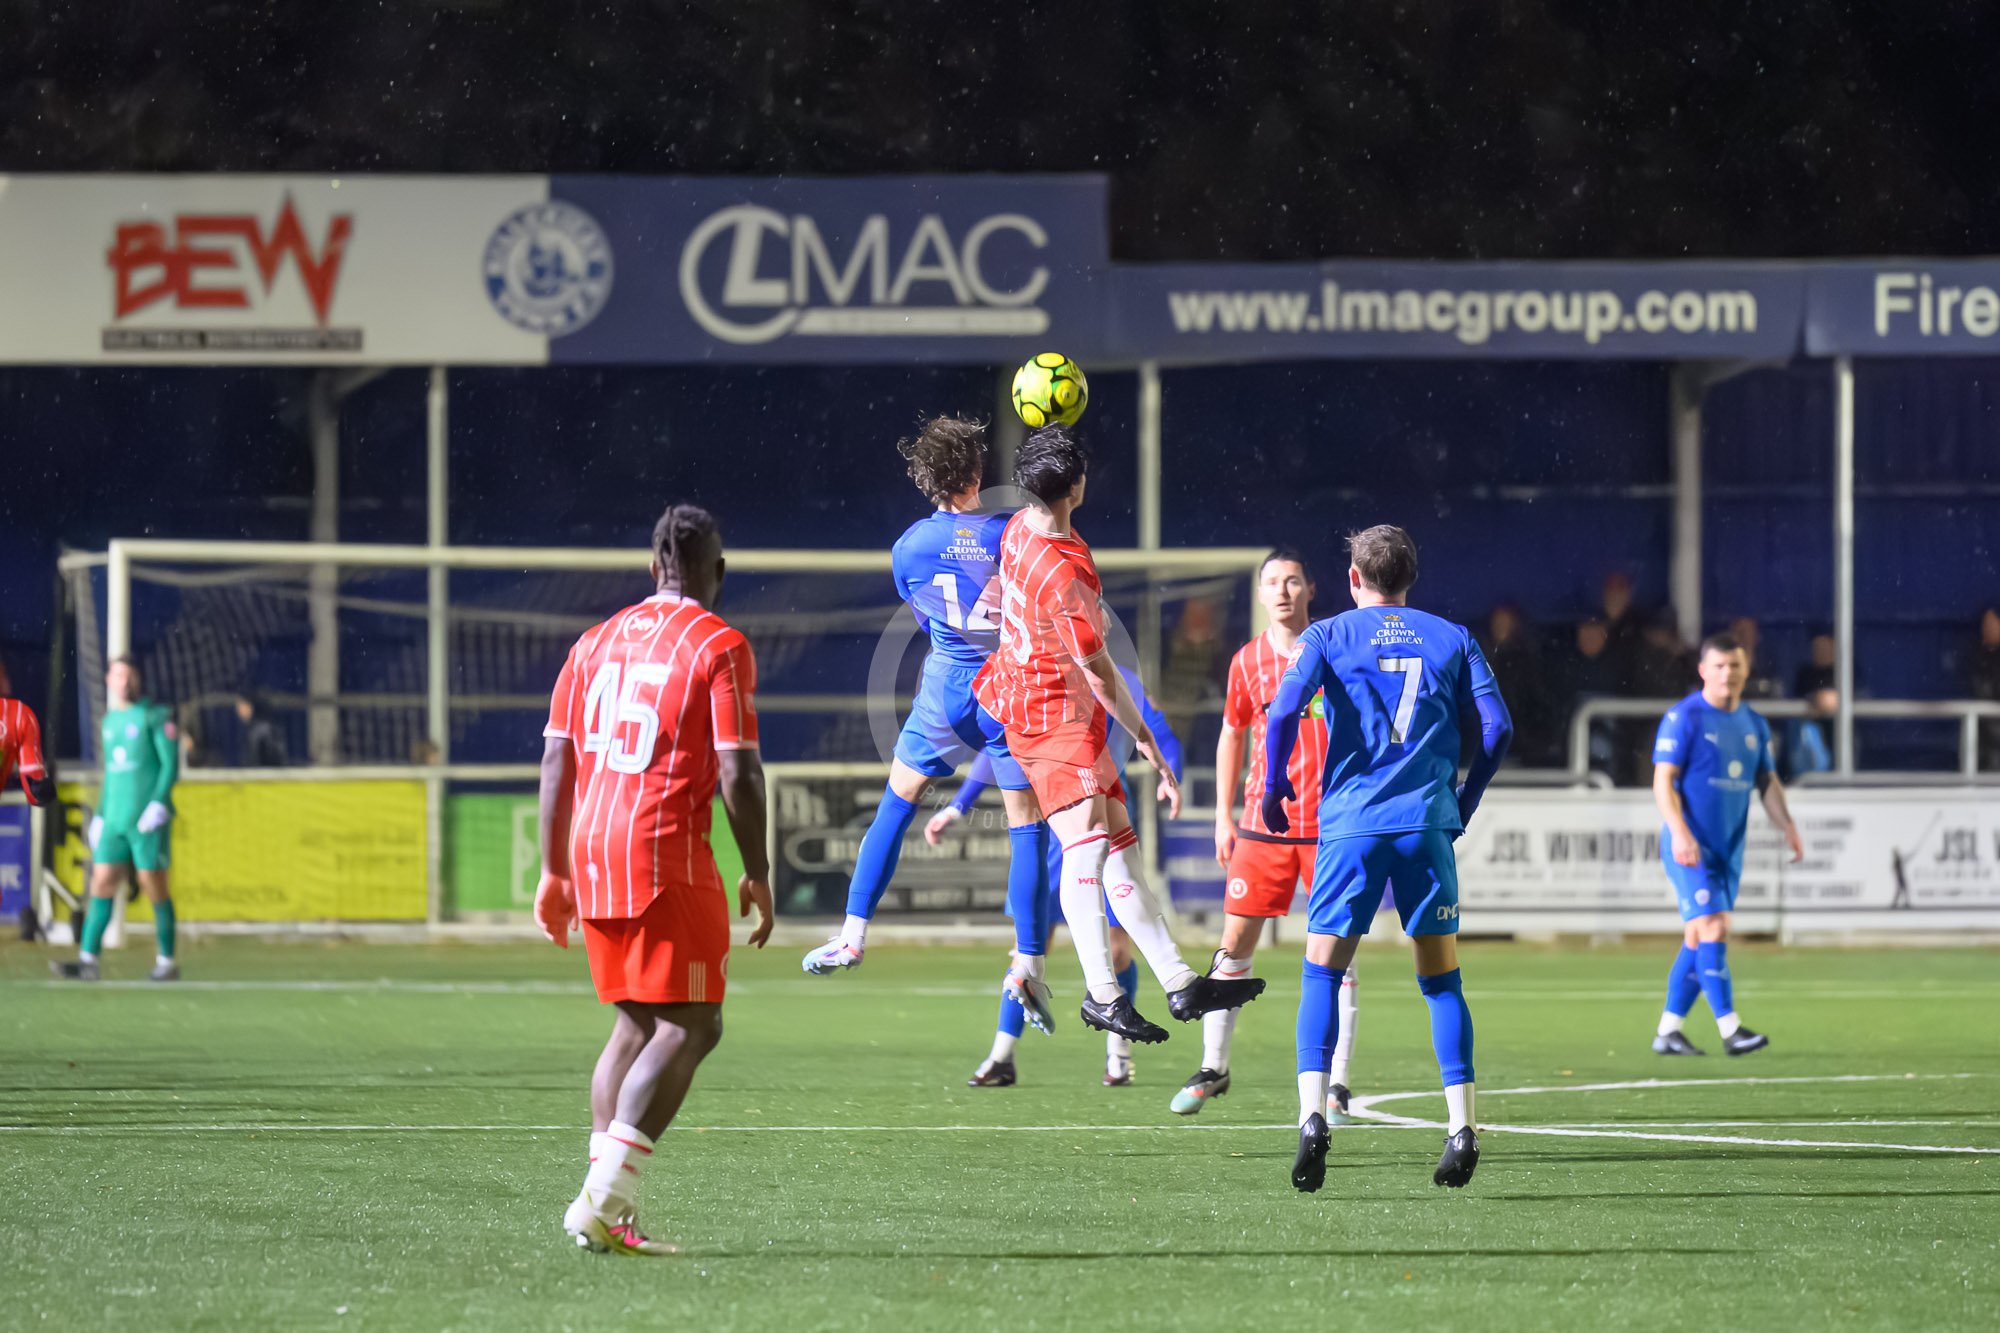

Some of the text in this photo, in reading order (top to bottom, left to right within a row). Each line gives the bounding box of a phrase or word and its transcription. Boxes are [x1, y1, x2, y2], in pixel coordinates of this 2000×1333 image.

[105, 190, 354, 326] BEW
[695, 204, 1050, 308] LMAC
[1168, 280, 1758, 344] www.lmacgroup.com
[1874, 272, 2000, 338] Fire
[939, 553, 996, 562] BILLERICAY
[946, 545, 987, 555] CROWN
[954, 538, 978, 546] THE
[1370, 636, 1424, 646] BILLERICAY
[1376, 629, 1416, 637] CROWN
[1382, 621, 1407, 629] THE
[583, 661, 673, 775] 45
[1378, 656, 1423, 744] 7
